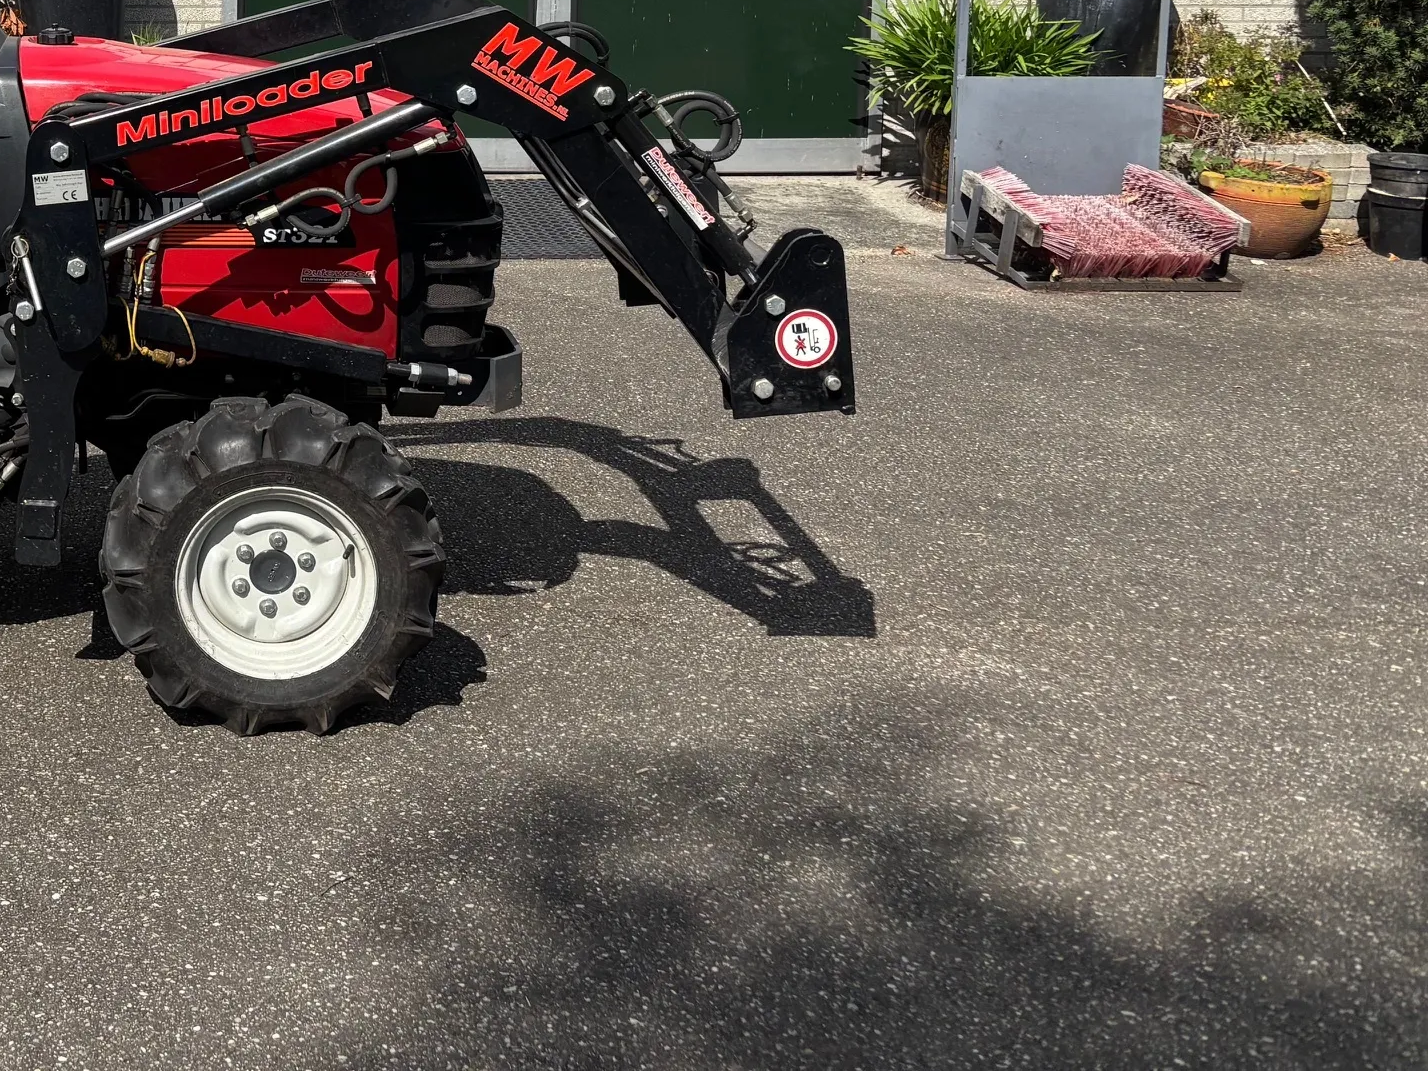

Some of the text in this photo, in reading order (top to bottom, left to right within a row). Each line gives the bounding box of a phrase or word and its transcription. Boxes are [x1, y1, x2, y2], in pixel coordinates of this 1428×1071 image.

[474, 51, 569, 118] MACHINES.NL
[481, 22, 596, 97] MW
[116, 60, 374, 147] Miniloader
[34, 175, 49, 183] MW
